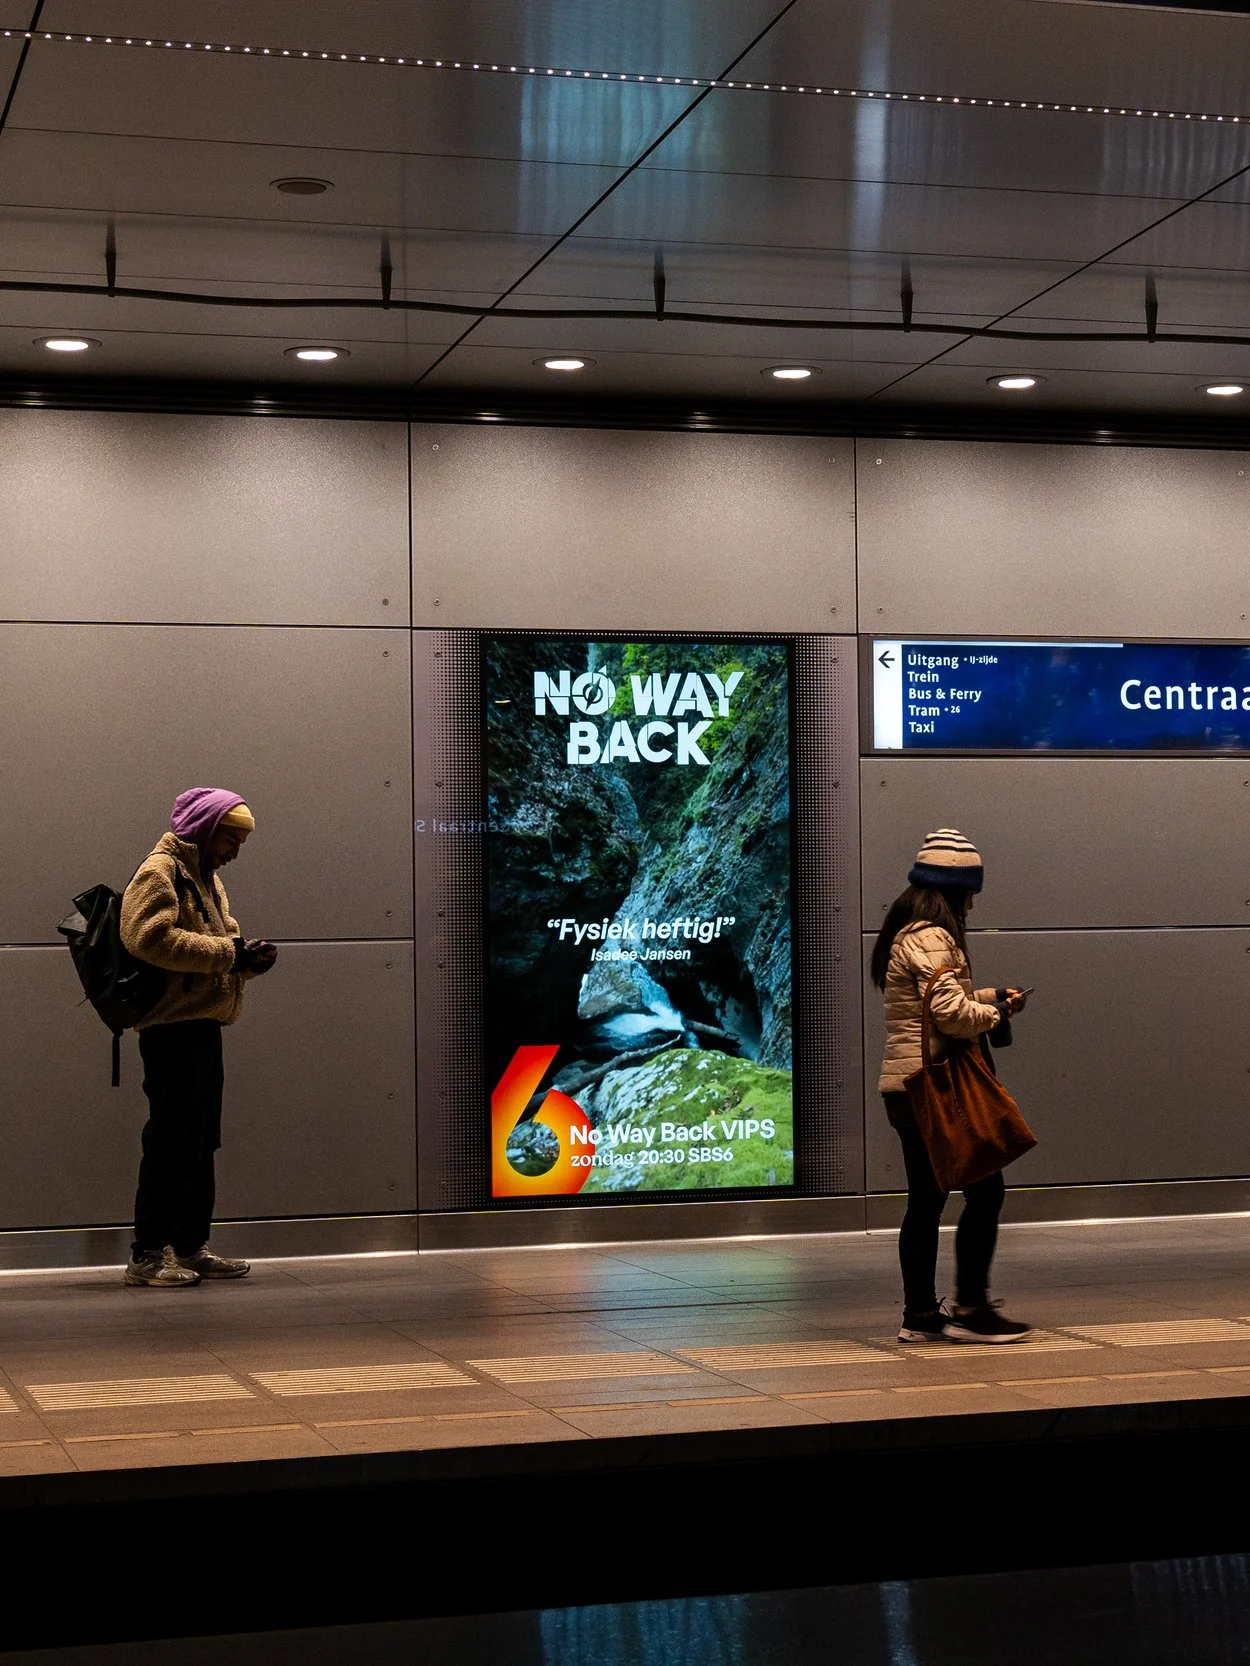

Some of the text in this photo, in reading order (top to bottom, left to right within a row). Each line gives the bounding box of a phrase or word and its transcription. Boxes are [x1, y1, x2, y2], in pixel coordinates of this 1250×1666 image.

[907, 653, 960, 669] Uitgang
[907, 671, 940, 683] Trein
[534, 665, 745, 718] NO WAY
[908, 688, 982, 703] Bus & Ferry
[908, 704, 961, 717] Tram 26
[908, 721, 935, 733] Taxi
[567, 720, 713, 765] BACK
[591, 947, 691, 962] Isadee Jansen
[569, 1119, 776, 1147] No Way Back VIPS
[570, 1147, 734, 1168] zondag 20:30 SBS6
